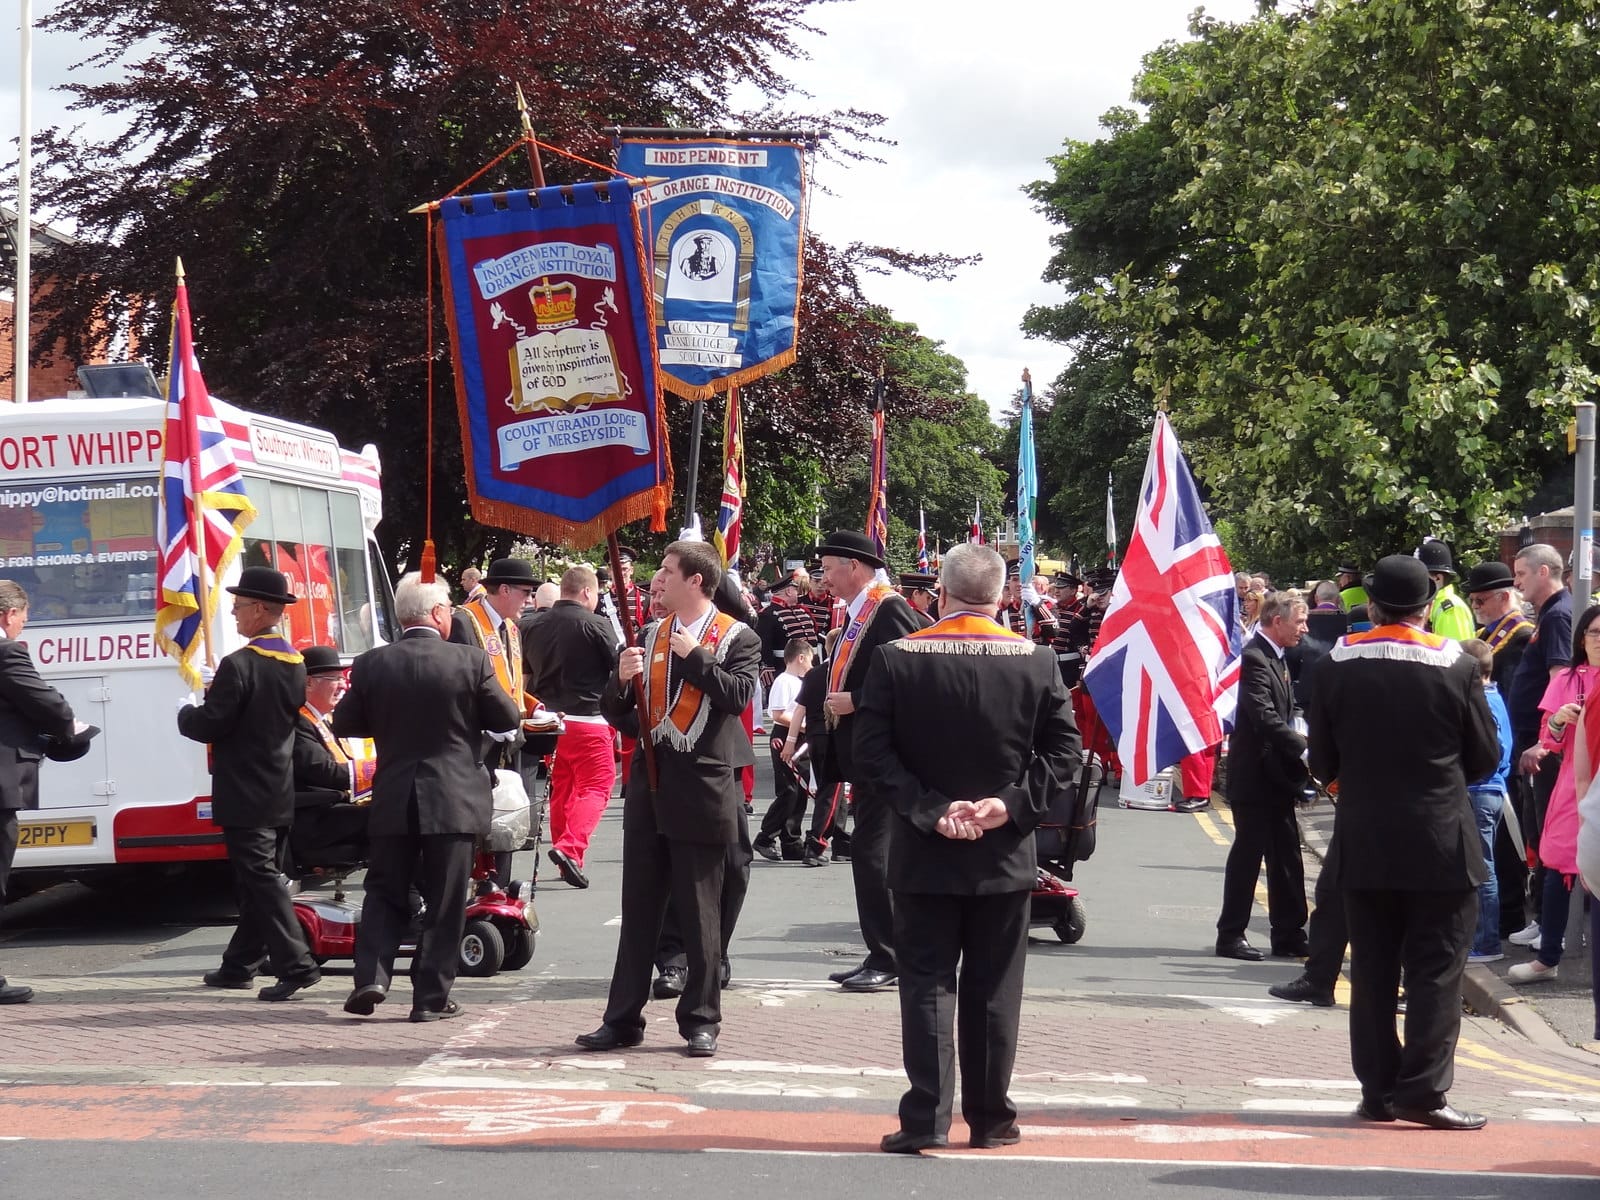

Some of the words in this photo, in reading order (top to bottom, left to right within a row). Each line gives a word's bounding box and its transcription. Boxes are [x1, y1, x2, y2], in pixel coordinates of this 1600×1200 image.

[654, 150, 760, 164] INDEPENDENT
[663, 177, 710, 197] ORANGE
[715, 178, 792, 217] INSTITUTION
[659, 202, 699, 243] JOHN
[713, 203, 753, 245] KNOX
[572, 248, 610, 265] LOYAL
[485, 265, 537, 294] ORANGE
[539, 259, 612, 279] NSTITUTION
[523, 346, 540, 361] All
[543, 344, 587, 359] Scripture
[589, 339, 600, 350] is
[522, 362, 546, 378] given
[555, 353, 611, 372] inspiration
[527, 376, 539, 390] of
[542, 375, 567, 388] GOD
[504, 420, 556, 442] COUNTY
[556, 415, 601, 432] GRAND
[604, 413, 637, 427] LODGE
[522, 437, 541, 452] OF
[548, 426, 626, 447] MERSEYSIDE
[0, 434, 58, 470] ORT
[256, 428, 301, 461] Southport
[302, 439, 333, 471] Whippy
[8, 556, 33, 568] FOR
[36, 553, 82, 567] SHOWS
[85, 553, 95, 564] &
[97, 550, 148, 563] EVENTS
[20, 825, 68, 844] 2PPY
